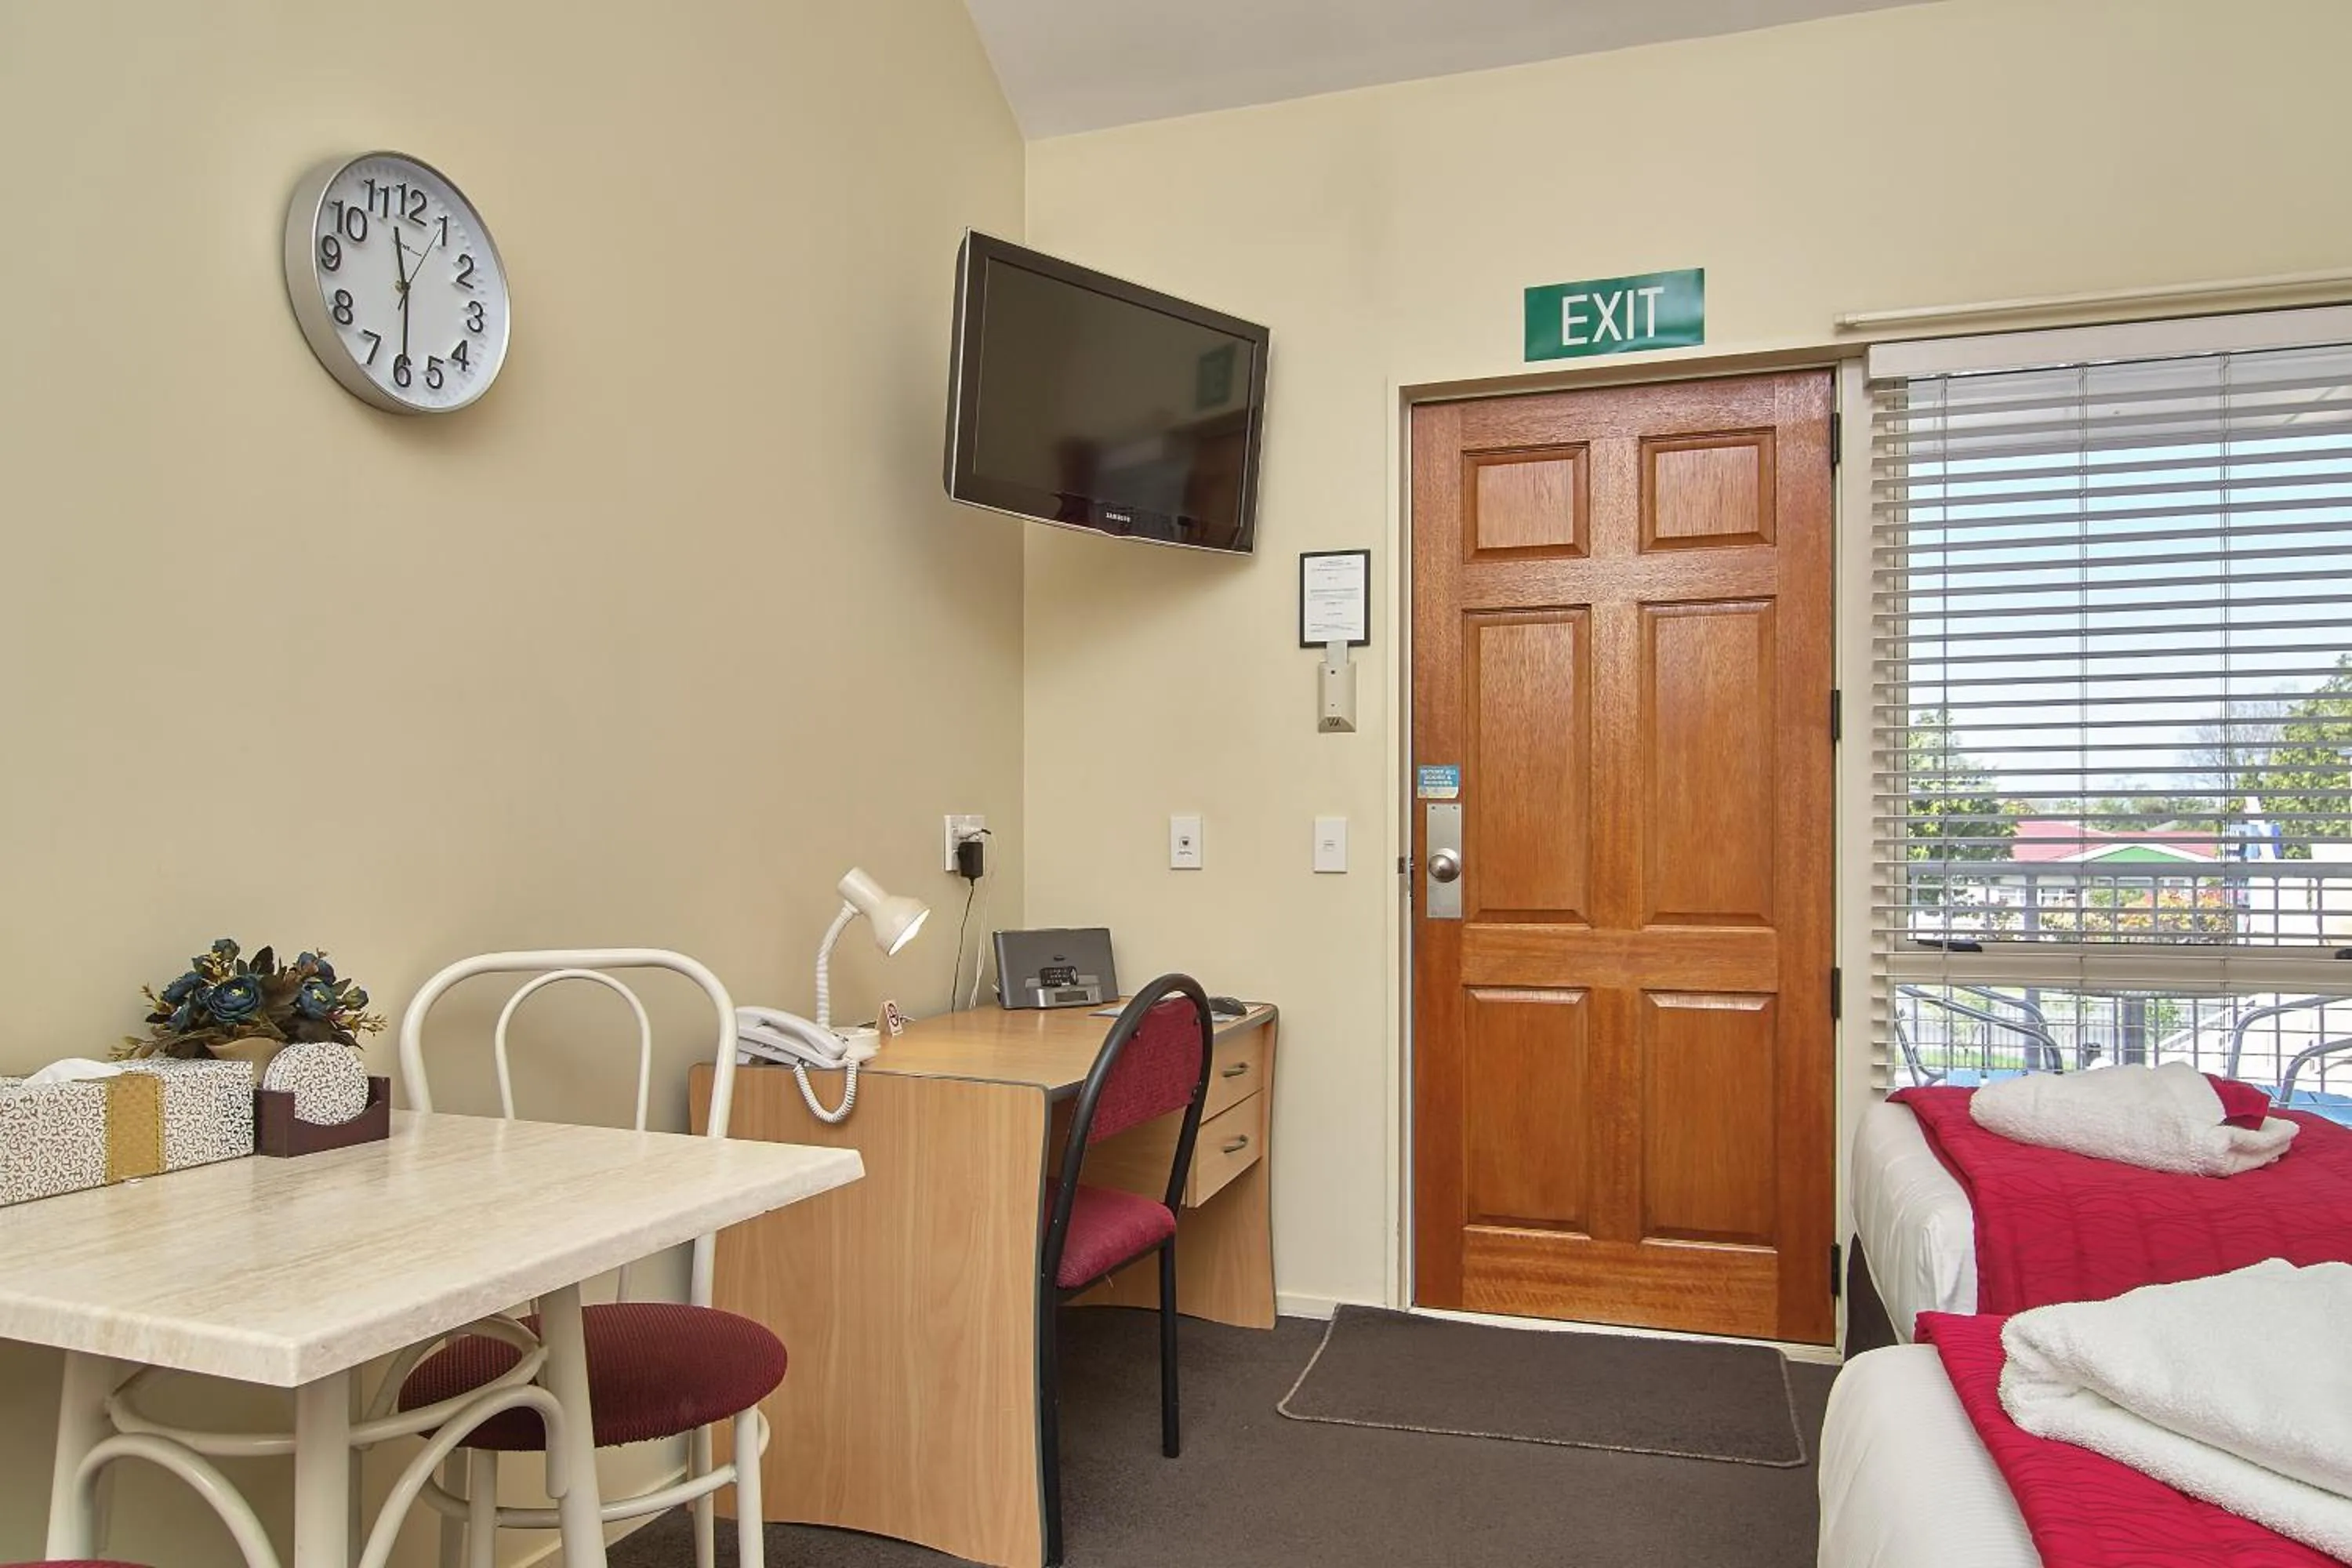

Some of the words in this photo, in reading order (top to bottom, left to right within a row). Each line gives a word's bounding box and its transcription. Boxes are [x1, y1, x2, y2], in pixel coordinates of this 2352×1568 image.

[364, 179, 389, 218] 11
[397, 183, 427, 226] 12
[332, 201, 368, 242] 10
[438, 216, 448, 246] 1
[321, 235, 342, 271] 9
[456, 254, 474, 289] 2
[333, 289, 353, 325] 8
[466, 301, 484, 333] 3
[1562, 286, 1664, 346] EXIT
[363, 329, 381, 365] 7
[452, 339, 469, 372] 4
[393, 354, 412, 387] 6
[426, 356, 445, 389] 5
